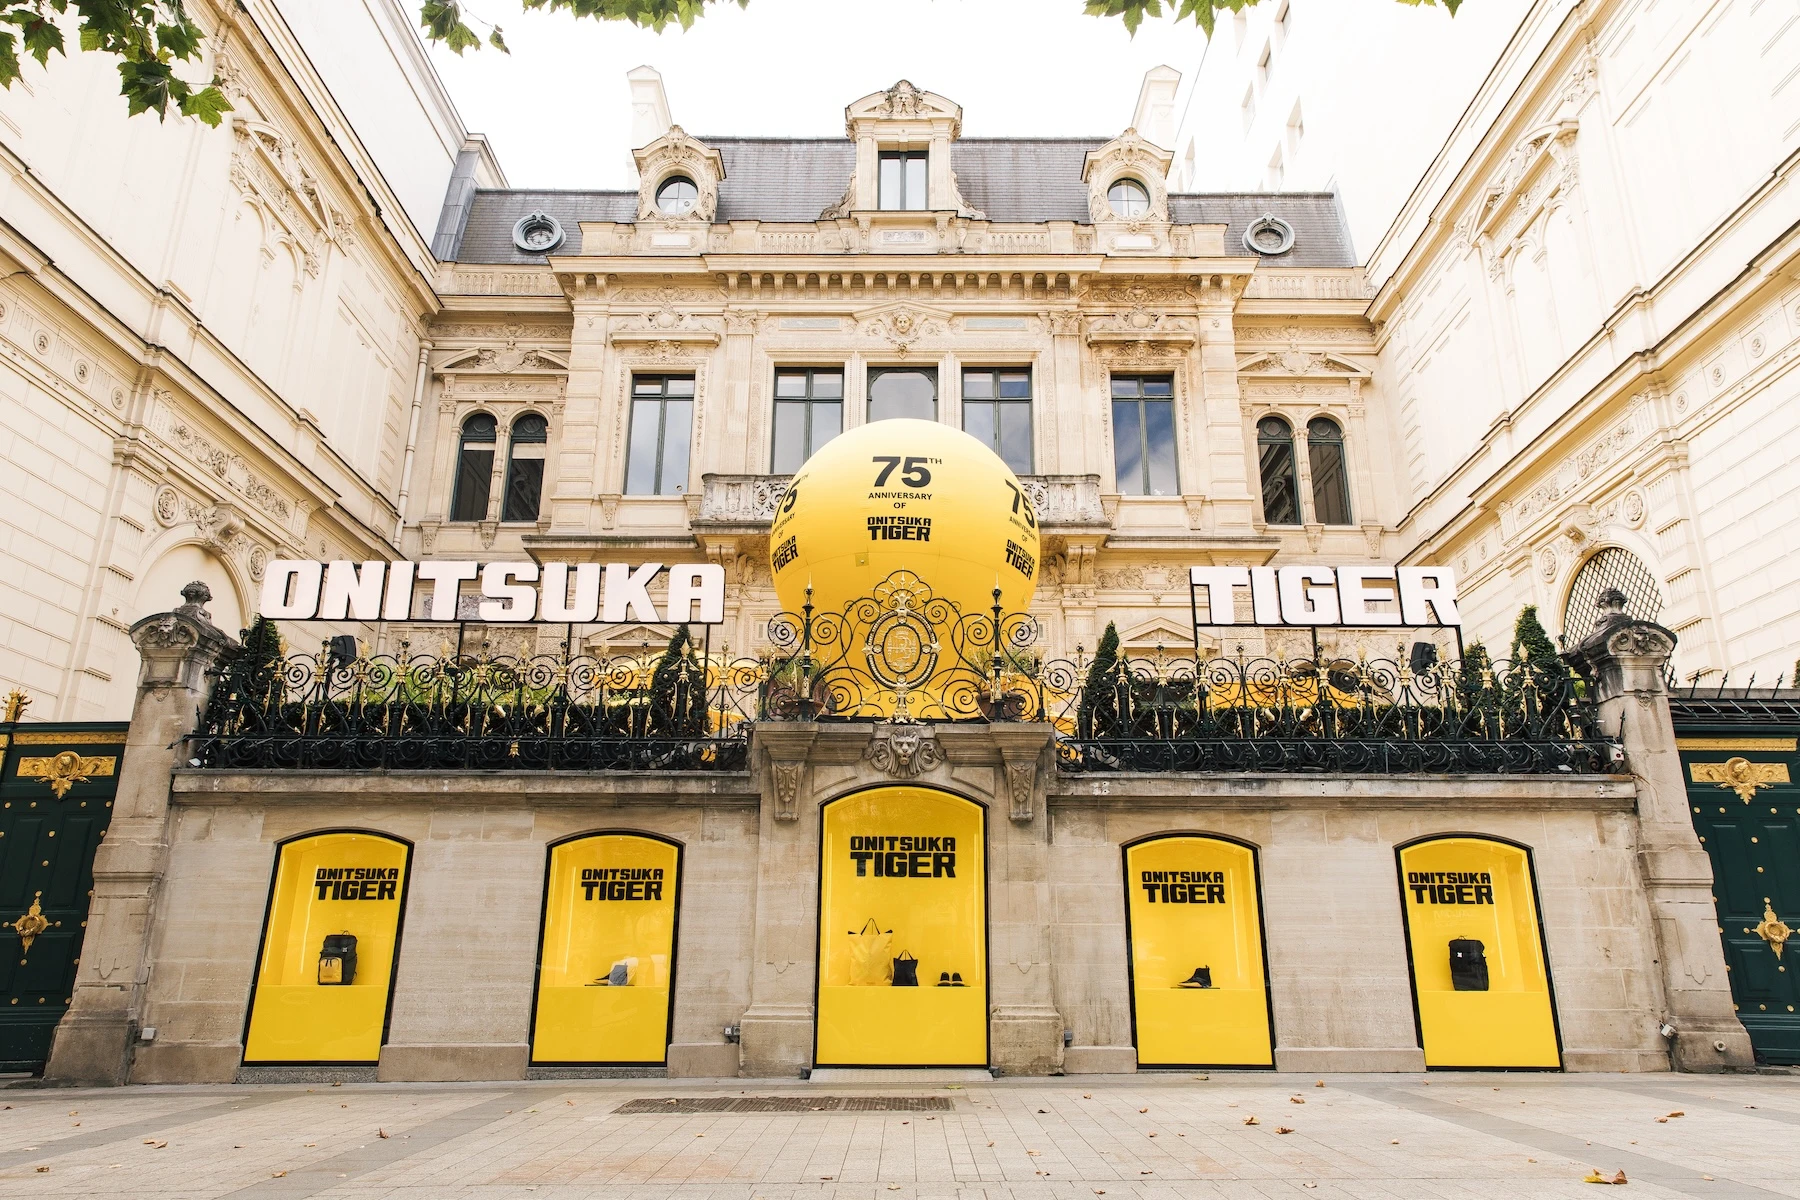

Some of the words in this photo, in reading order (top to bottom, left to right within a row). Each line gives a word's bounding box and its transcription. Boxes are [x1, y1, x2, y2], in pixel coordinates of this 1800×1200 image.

[868, 492, 932, 501] ANNIVERSARY
[867, 516, 931, 527] ONITSUKA
[867, 525, 931, 541] TIGER
[1021, 534, 1028, 543] OF
[773, 543, 799, 574] TIGER
[1006, 547, 1034, 580] TIGER
[259, 559, 726, 623] ONITSUKA
[1190, 566, 1462, 625] TIGER
[850, 836, 956, 851] ONITSUKA
[316, 867, 399, 881] ONITSUKA
[850, 852, 956, 878] TIGER
[581, 868, 664, 881] ONITSUKA
[1141, 871, 1224, 883] ONITSUKA
[1408, 872, 1491, 884] ONITSUKA
[314, 880, 396, 901] TIGER
[581, 881, 663, 901] TIGER
[1142, 884, 1226, 904] TIGER
[1409, 884, 1494, 905] TIGER
